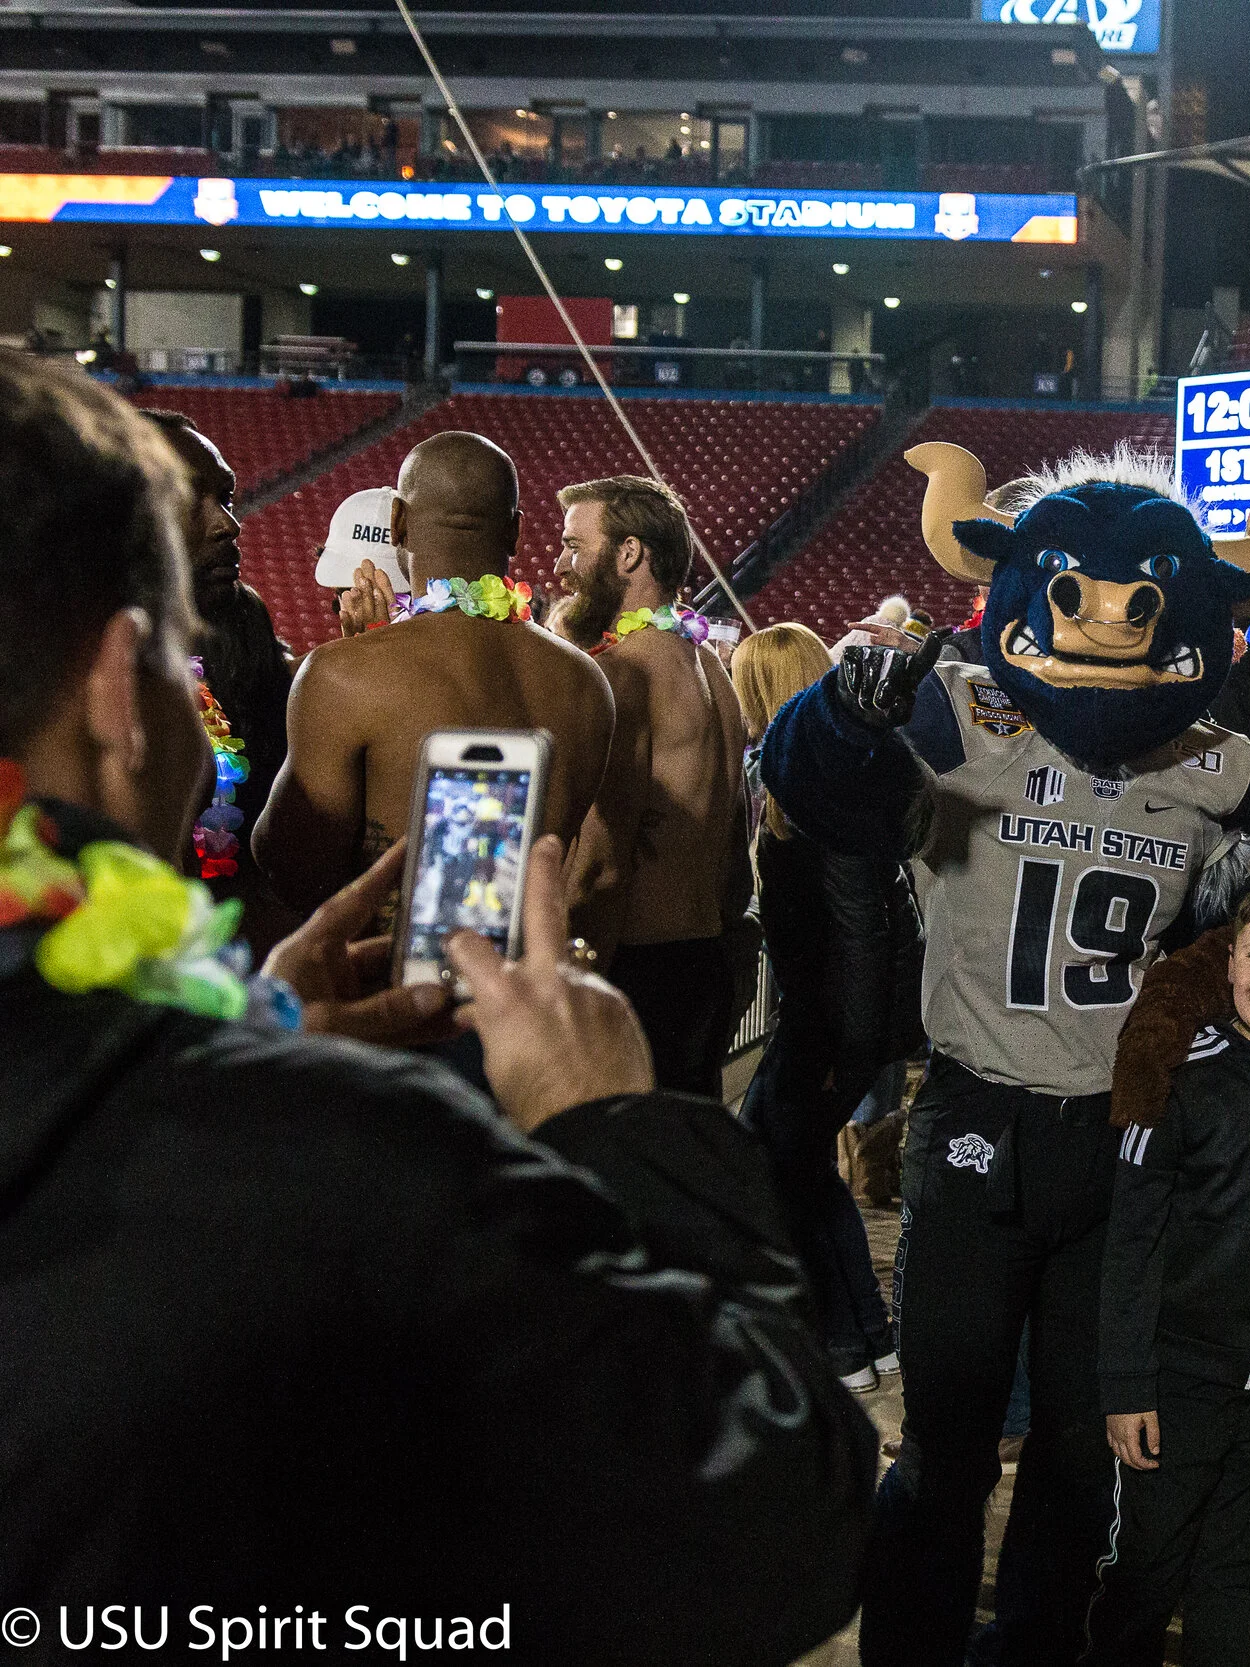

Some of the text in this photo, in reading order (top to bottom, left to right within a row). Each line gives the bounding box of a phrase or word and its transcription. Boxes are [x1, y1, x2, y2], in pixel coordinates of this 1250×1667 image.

[259, 189, 917, 230] WELCOME TO TOYOTA STADIUM
[352, 523, 391, 544] BABE
[975, 708, 1002, 719] FRISCO
[1091, 776, 1123, 791] STATE
[998, 813, 1189, 871] UTAH STATE
[1005, 855, 1160, 1011] 19
